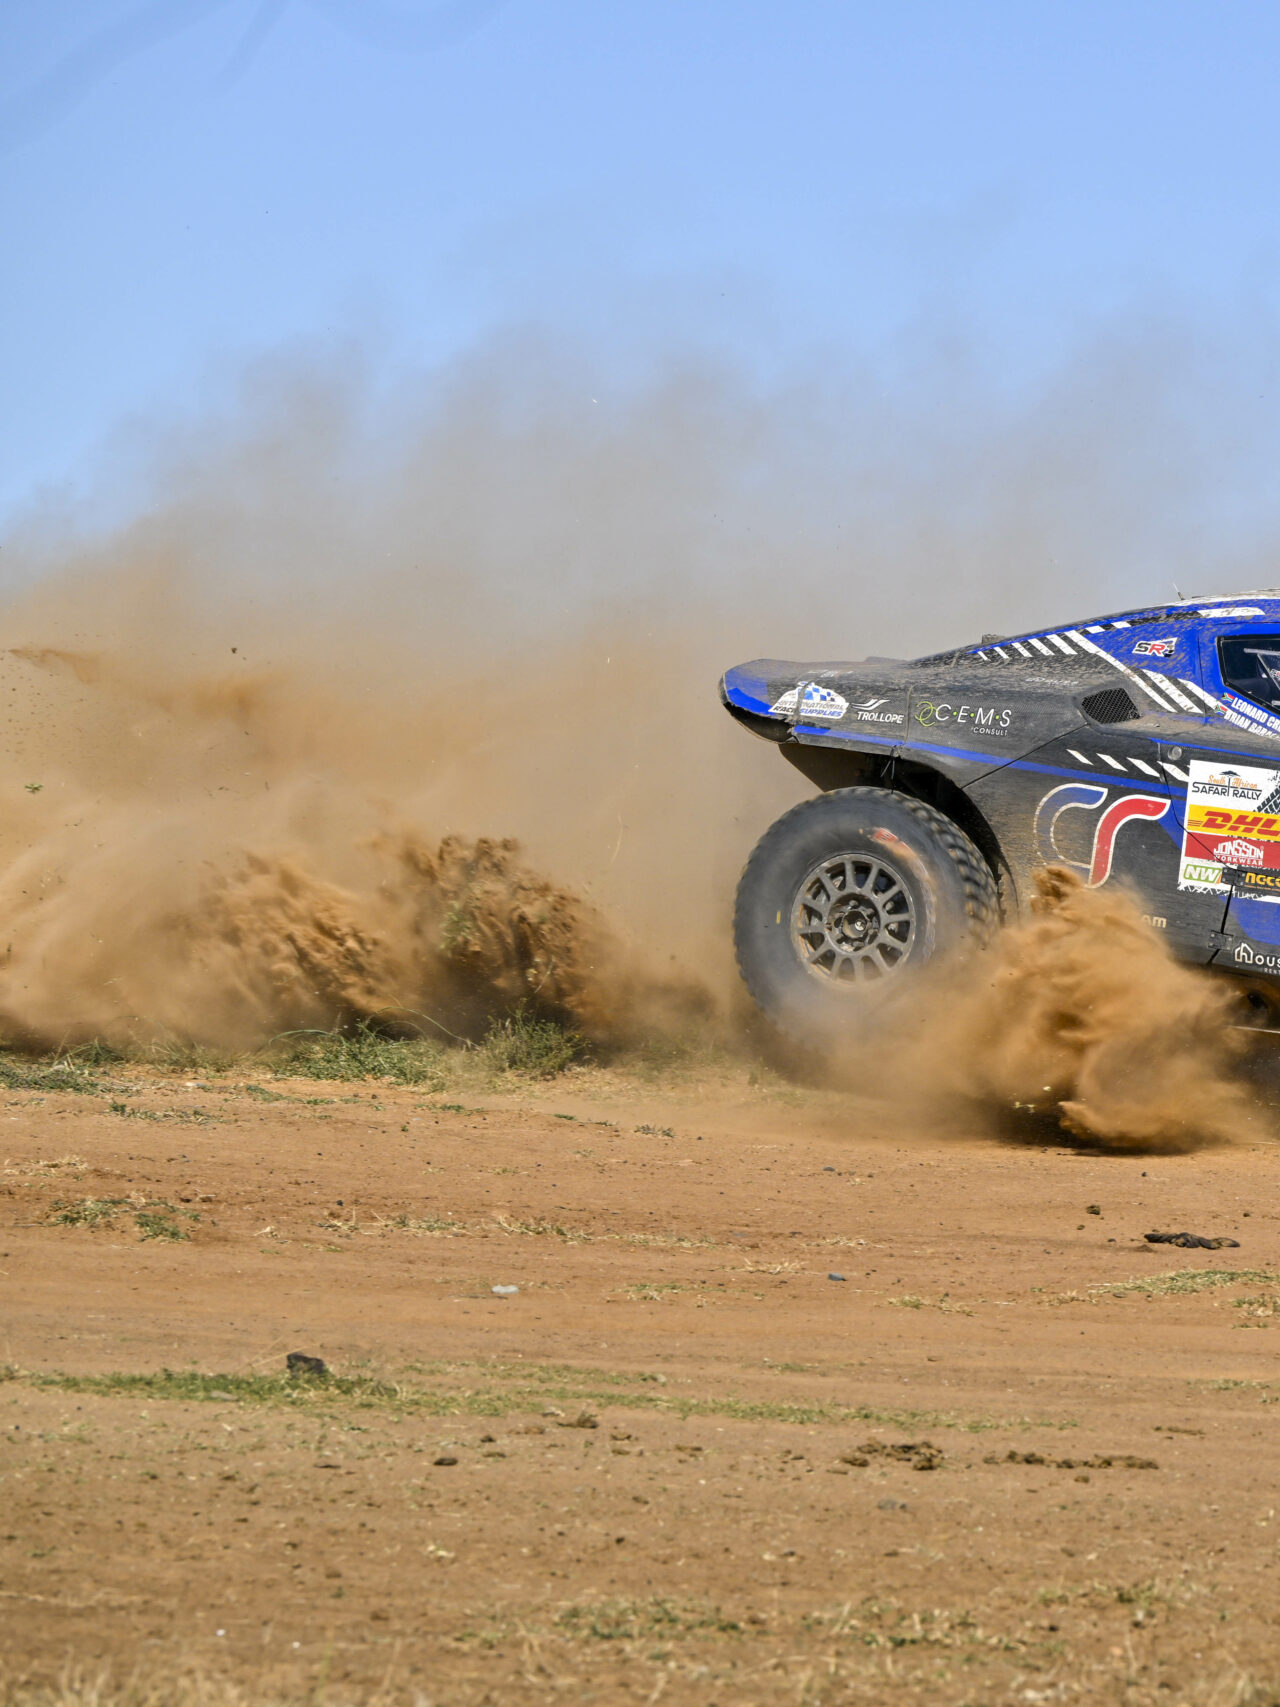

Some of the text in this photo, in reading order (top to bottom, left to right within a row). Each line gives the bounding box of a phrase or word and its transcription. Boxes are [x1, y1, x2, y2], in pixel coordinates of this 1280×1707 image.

[800, 708, 843, 717] SUPPLIES
[857, 711, 905, 723] TROLLOPE
[1231, 697, 1269, 724] LEONARD
[1224, 710, 1251, 730] BRIAN
[1191, 781, 1262, 800] SAFARI RALLY
[1208, 774, 1258, 789] South African
[1201, 811, 1280, 837] DHL
[1213, 839, 1264, 860] JONSSON
[1214, 854, 1263, 866] WORKWEAR
[1185, 865, 1219, 883] NW
